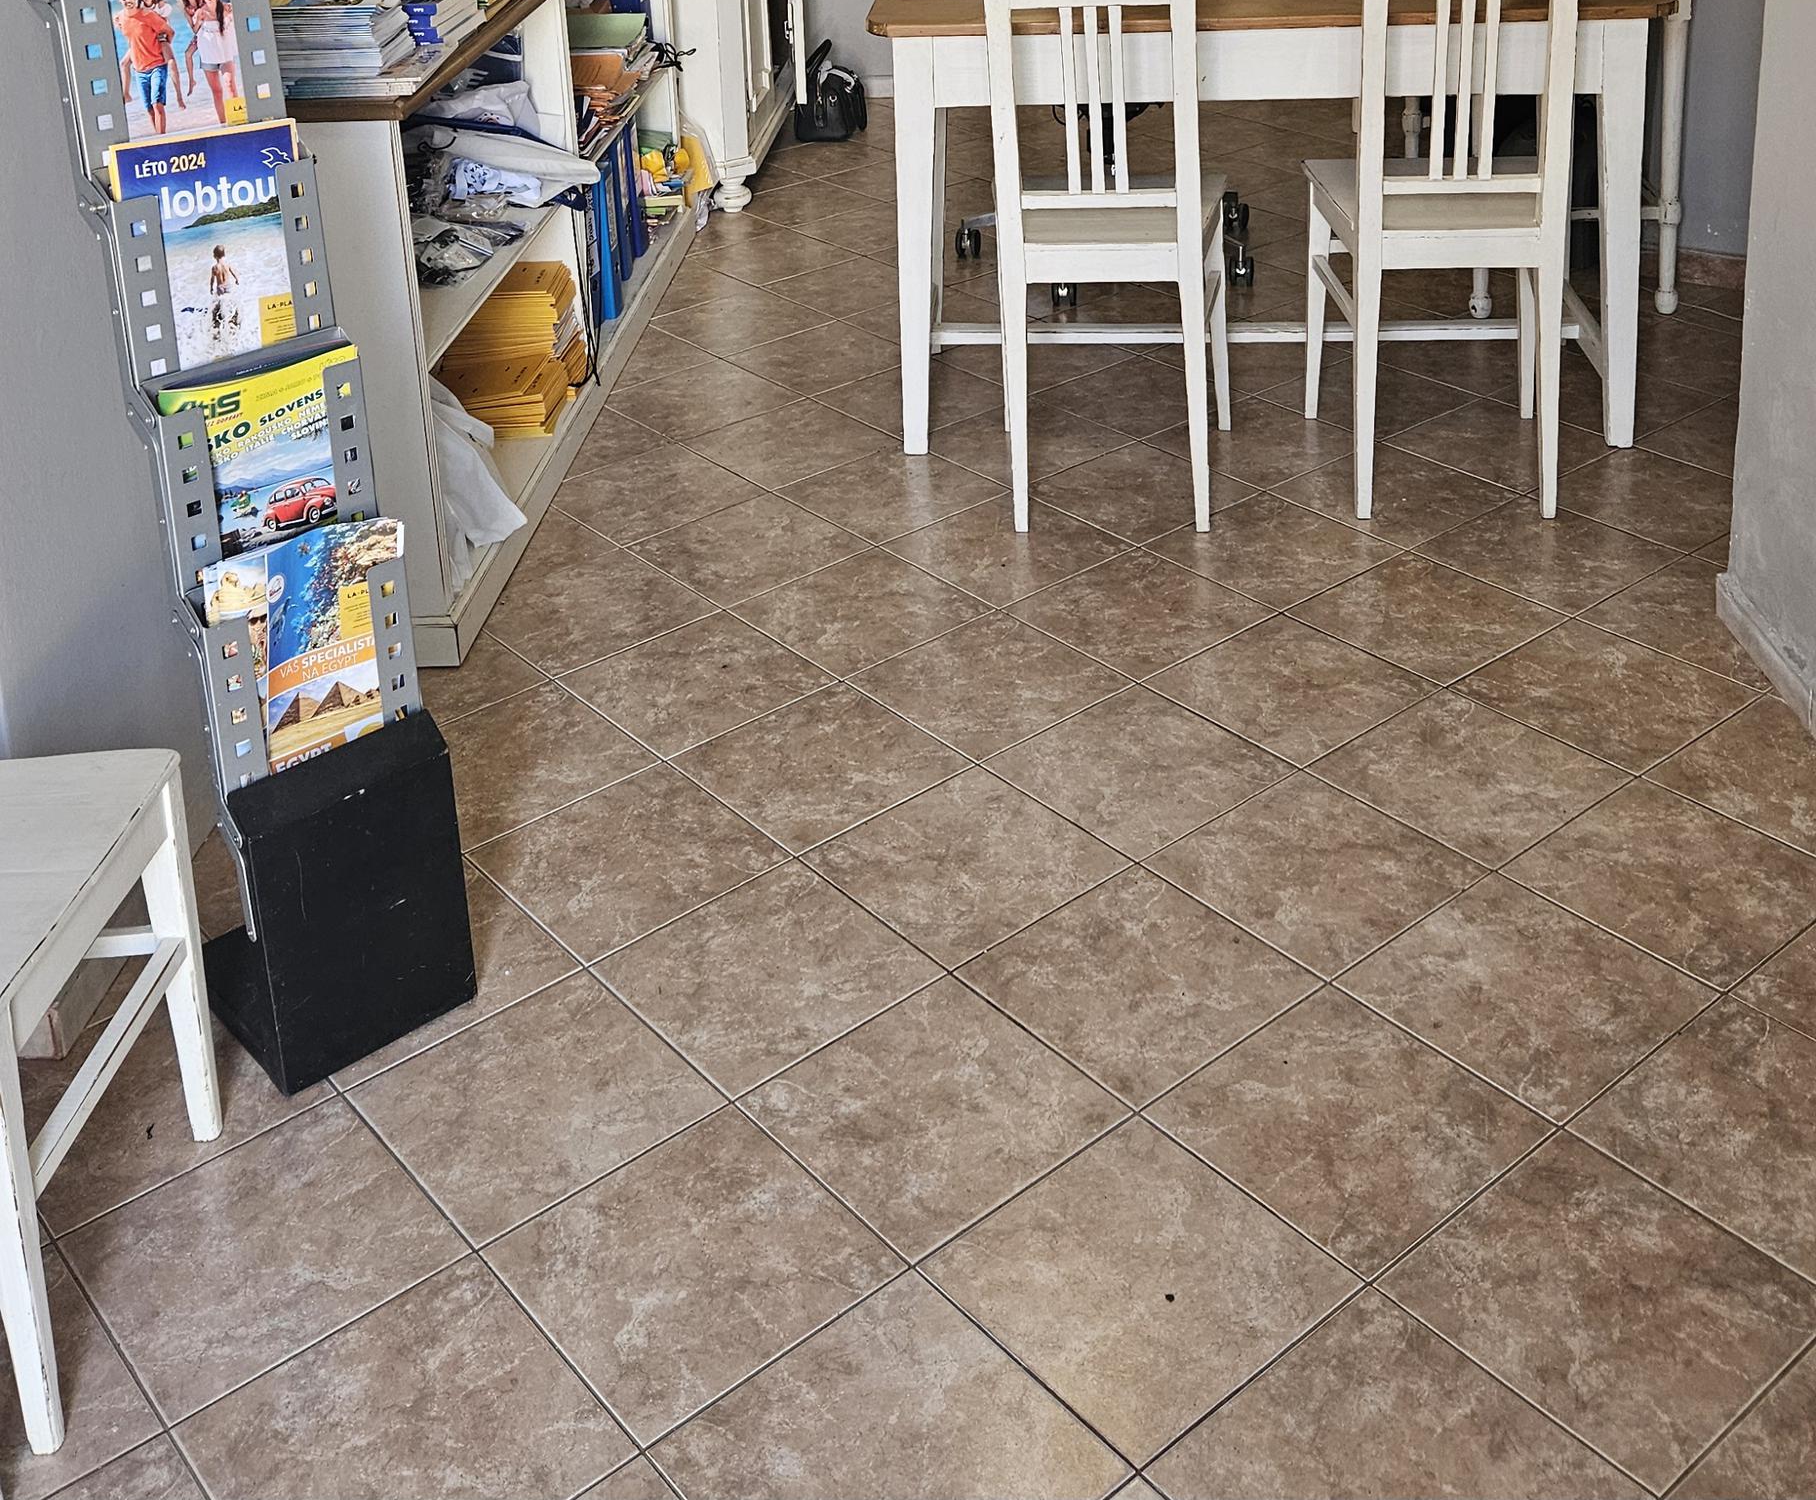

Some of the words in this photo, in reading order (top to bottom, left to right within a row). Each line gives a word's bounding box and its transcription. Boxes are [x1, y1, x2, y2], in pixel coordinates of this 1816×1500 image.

[134, 160, 168, 179] LÉTO
[169, 151, 207, 174] 2024
[259, 388, 324, 427] SLOVENS
[237, 416, 293, 449] RAKOUSKO
[301, 667, 320, 682] NA
[321, 652, 359, 675] EGYPT
